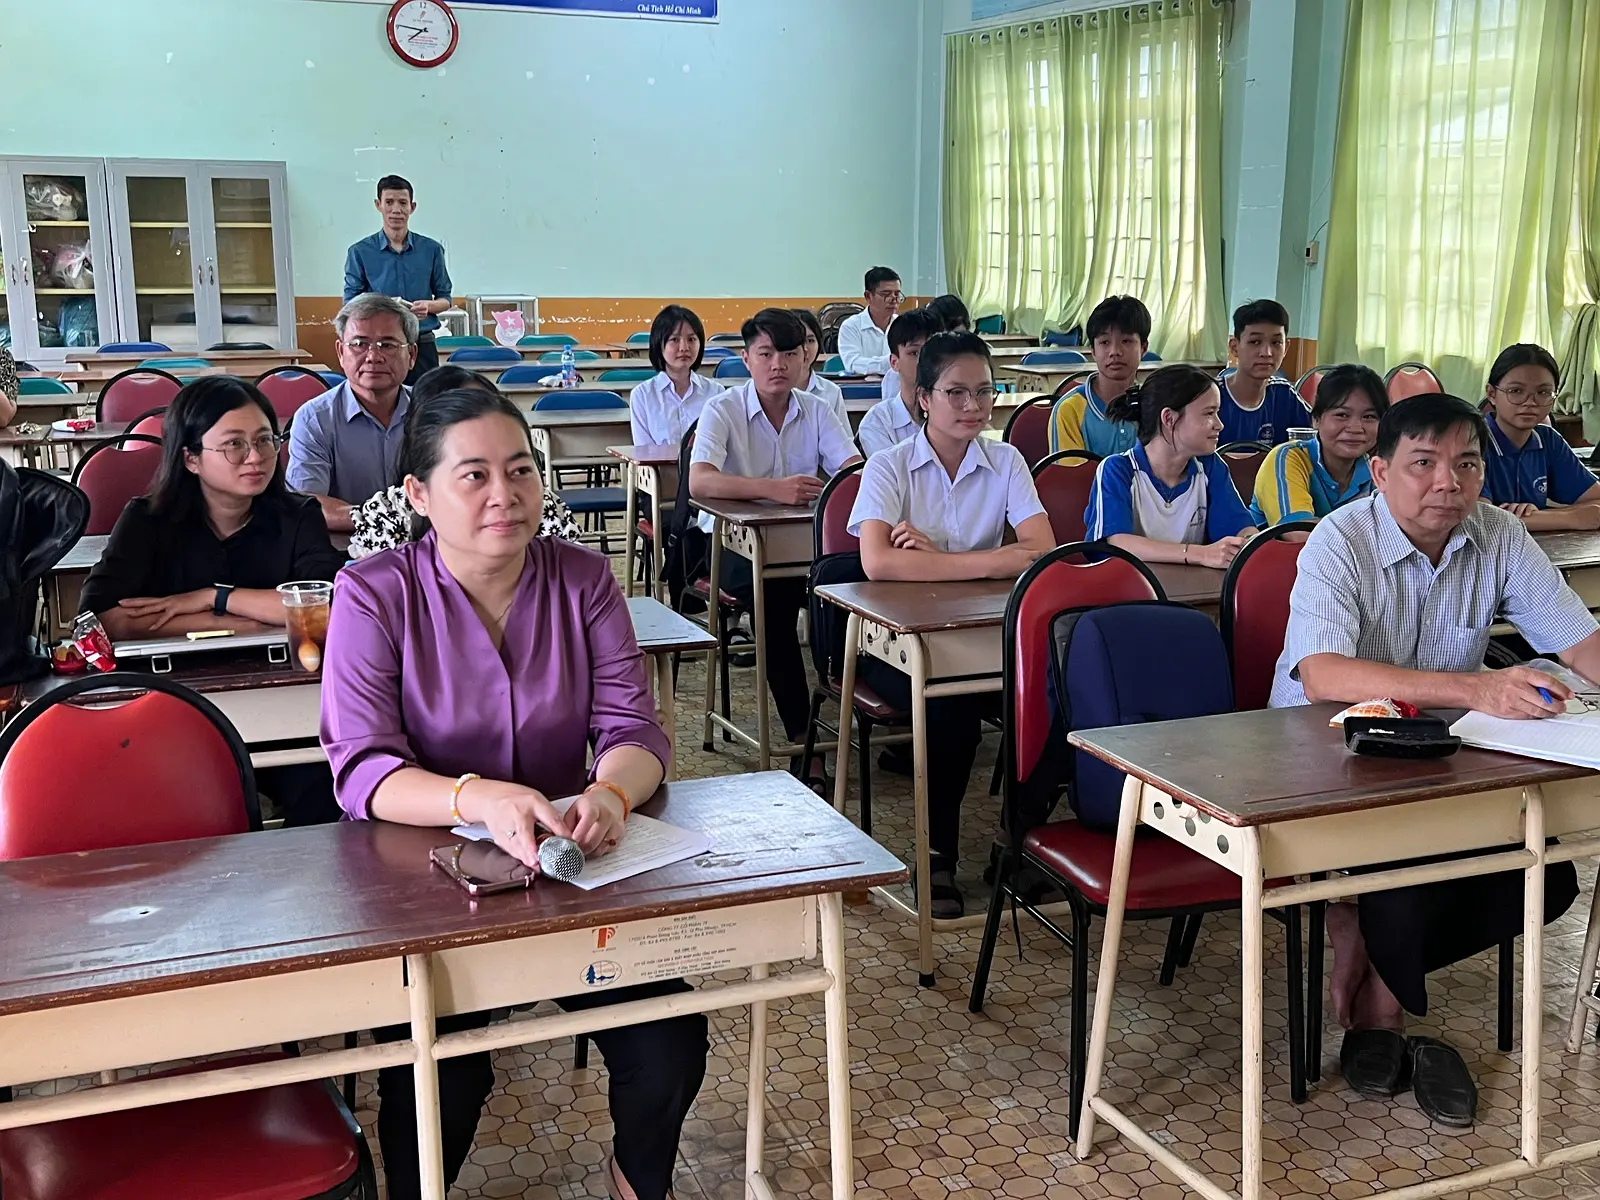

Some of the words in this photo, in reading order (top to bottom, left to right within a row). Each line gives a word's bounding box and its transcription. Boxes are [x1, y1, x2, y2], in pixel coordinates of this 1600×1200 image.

[637, 4, 650, 12] Chủ
[651, 4, 664, 13] Tịch
[665, 4, 674, 13] Hồ
[675, 6, 686, 14] Chí
[686, 6, 702, 15] Minh
